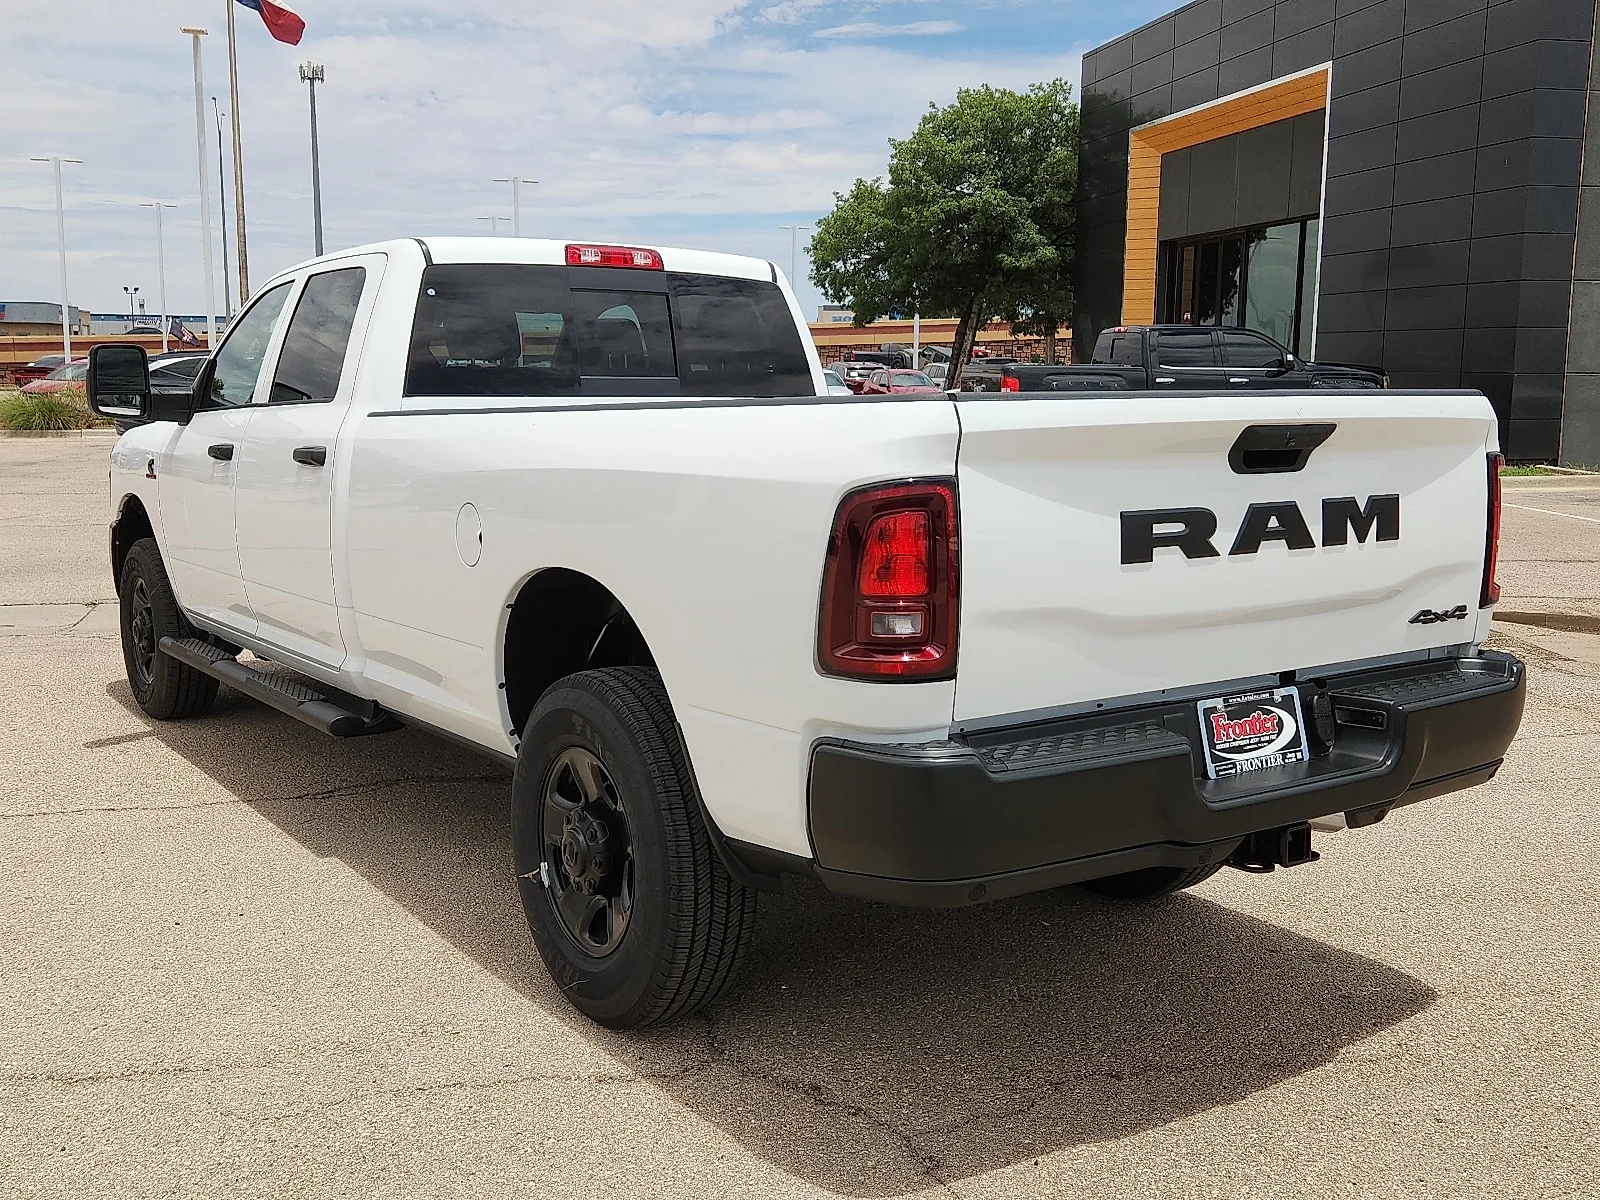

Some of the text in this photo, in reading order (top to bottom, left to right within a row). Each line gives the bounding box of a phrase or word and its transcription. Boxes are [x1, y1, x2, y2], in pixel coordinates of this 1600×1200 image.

[1120, 494, 1399, 565] RAM
[1211, 711, 1278, 742] Frontier
[1235, 753, 1284, 773] FRONTIER
